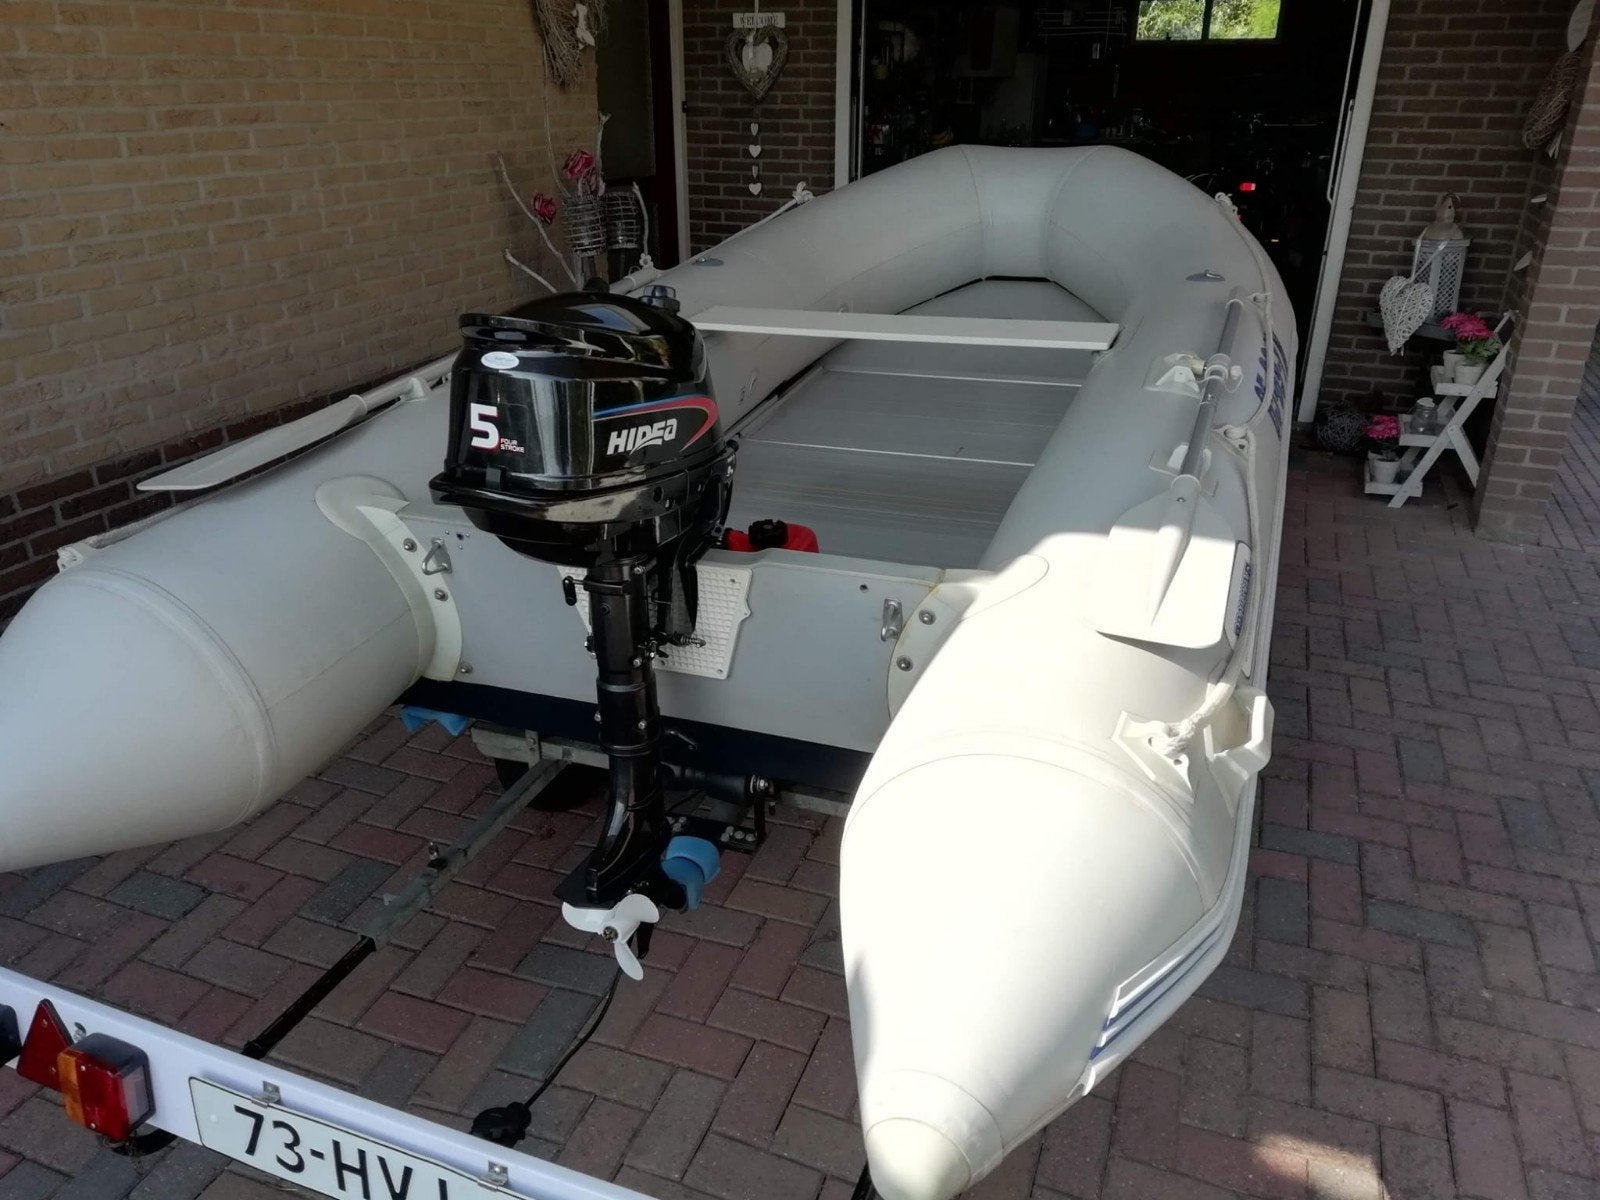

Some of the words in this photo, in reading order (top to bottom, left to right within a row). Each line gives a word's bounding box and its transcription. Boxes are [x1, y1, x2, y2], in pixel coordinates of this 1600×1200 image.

[470, 403, 500, 450] 5
[606, 418, 677, 455] HIDEA
[500, 438, 518, 446] FOUR
[500, 444, 525, 454] STROKE
